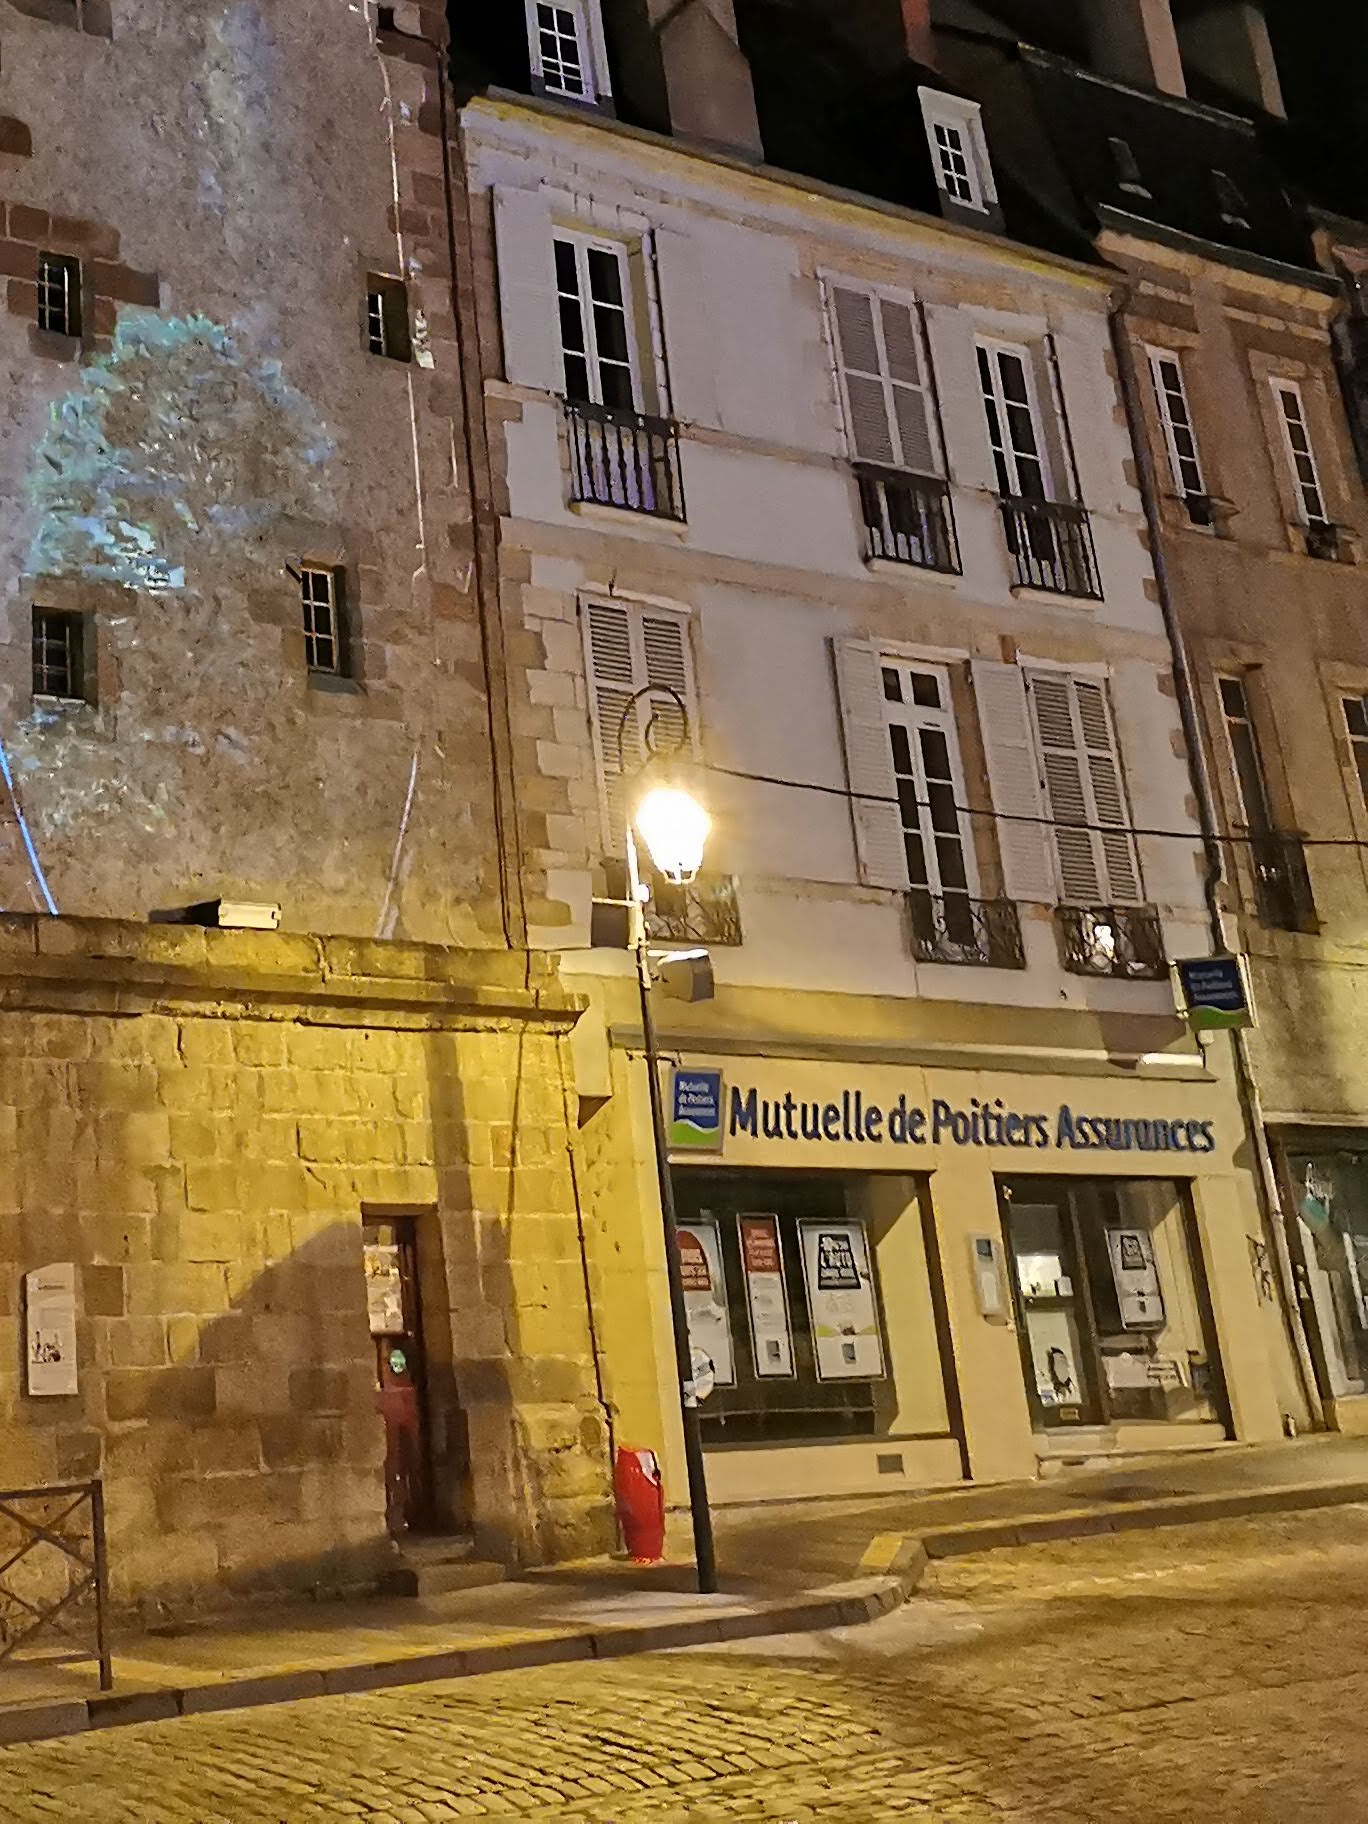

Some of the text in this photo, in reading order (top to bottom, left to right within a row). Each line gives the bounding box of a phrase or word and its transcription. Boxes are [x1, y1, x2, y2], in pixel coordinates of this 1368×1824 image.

[729, 1086, 1216, 1153] Mutuelle de Poitiers Assurances
